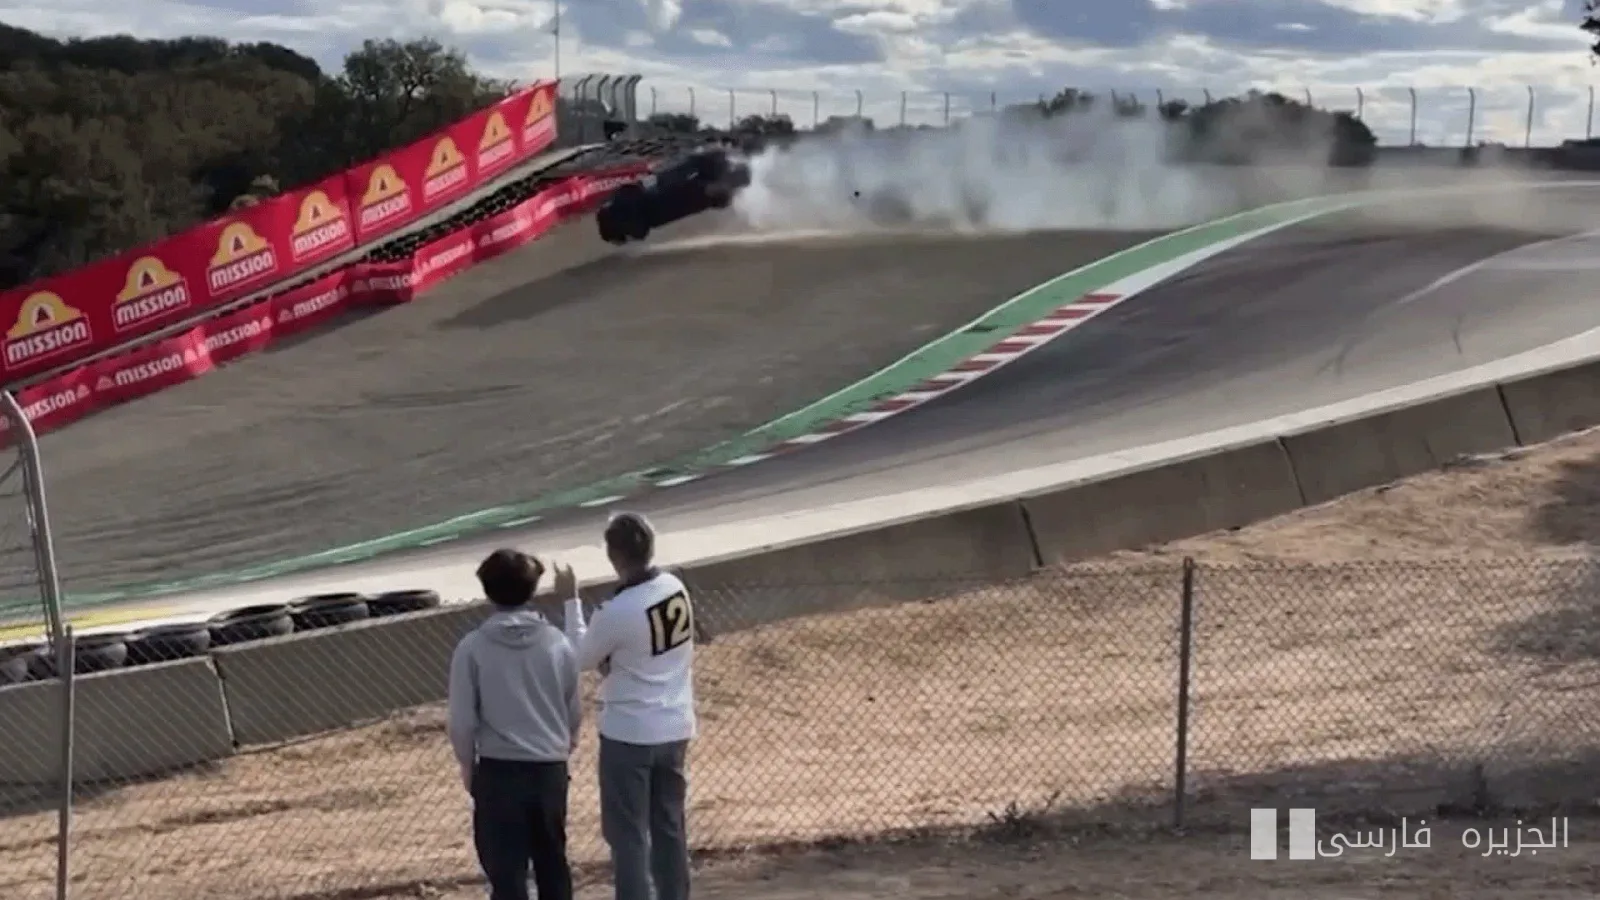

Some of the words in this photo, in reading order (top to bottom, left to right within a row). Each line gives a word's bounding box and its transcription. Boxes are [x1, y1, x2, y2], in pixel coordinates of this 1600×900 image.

[211, 251, 273, 288] MISSION
[116, 287, 186, 325] MISSION
[8, 321, 87, 362] MISSION
[115, 354, 183, 386] MISSION
[651, 597, 690, 651] 12
